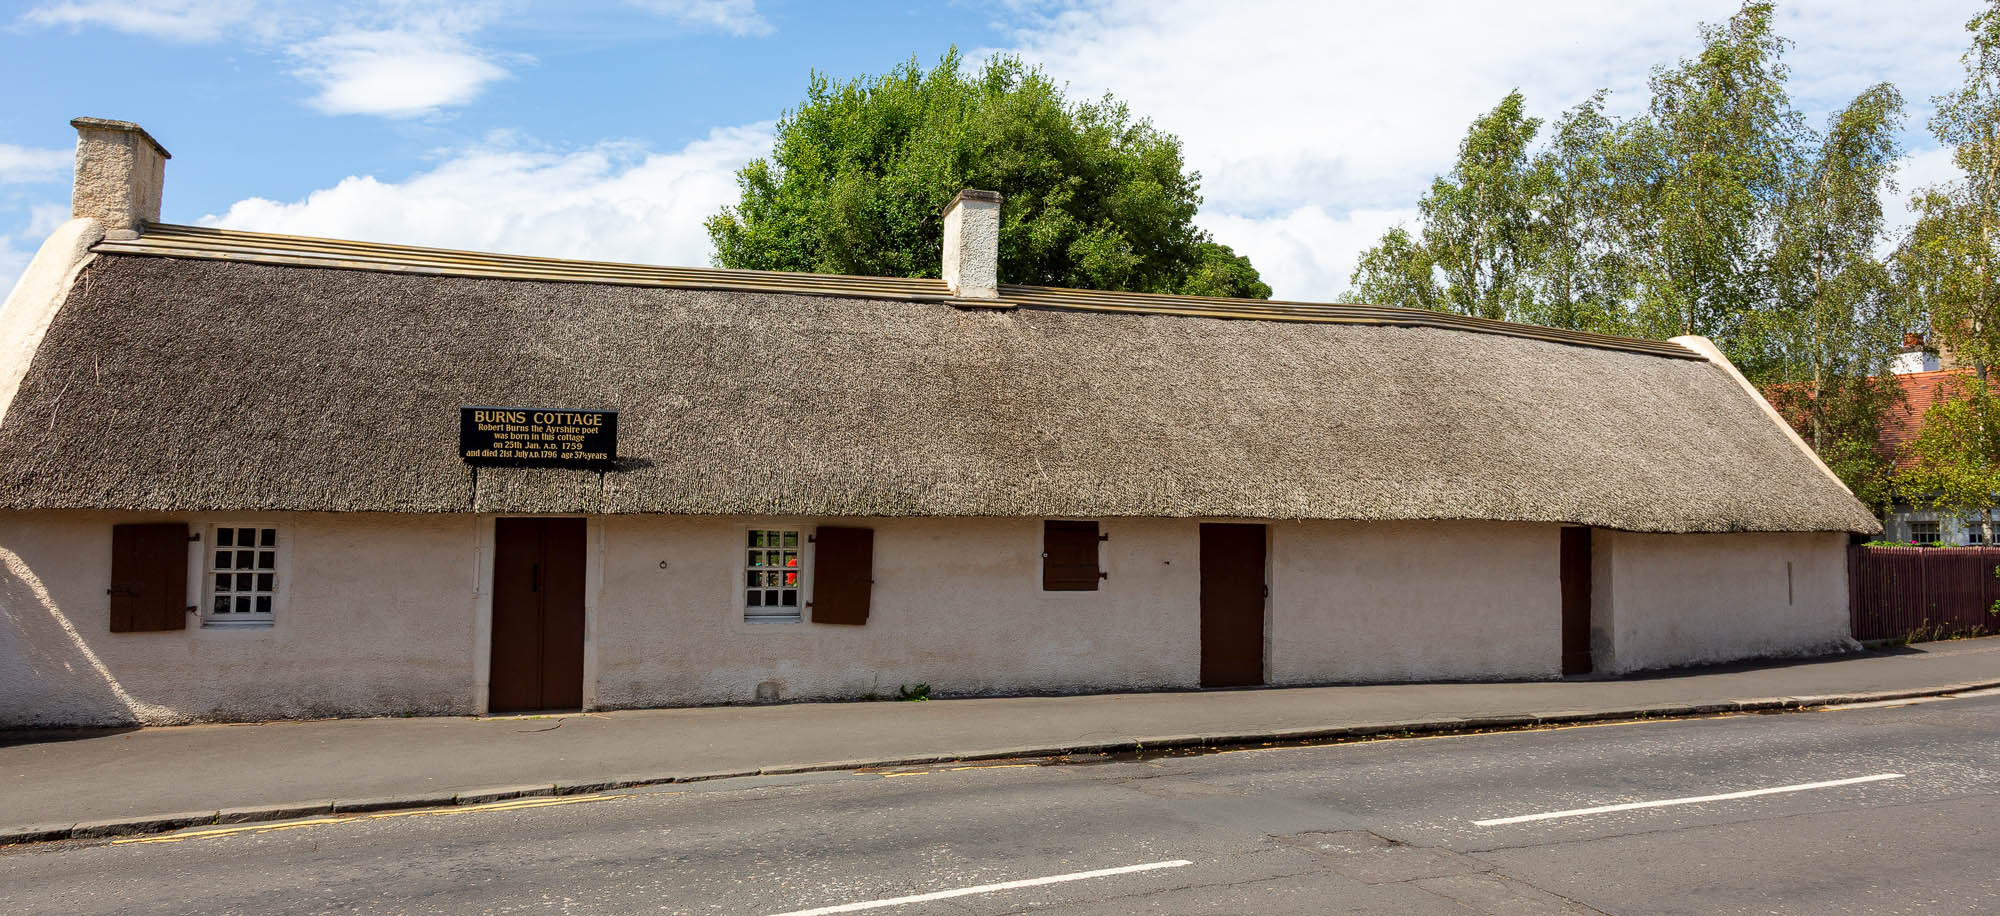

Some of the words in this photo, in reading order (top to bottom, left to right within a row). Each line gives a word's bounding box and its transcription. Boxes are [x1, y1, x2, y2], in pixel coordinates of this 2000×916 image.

[474, 411, 526, 423] BURNS
[534, 412, 602, 426] COTTAGE
[546, 426, 579, 434] Ayrshire
[514, 450, 528, 459] July
